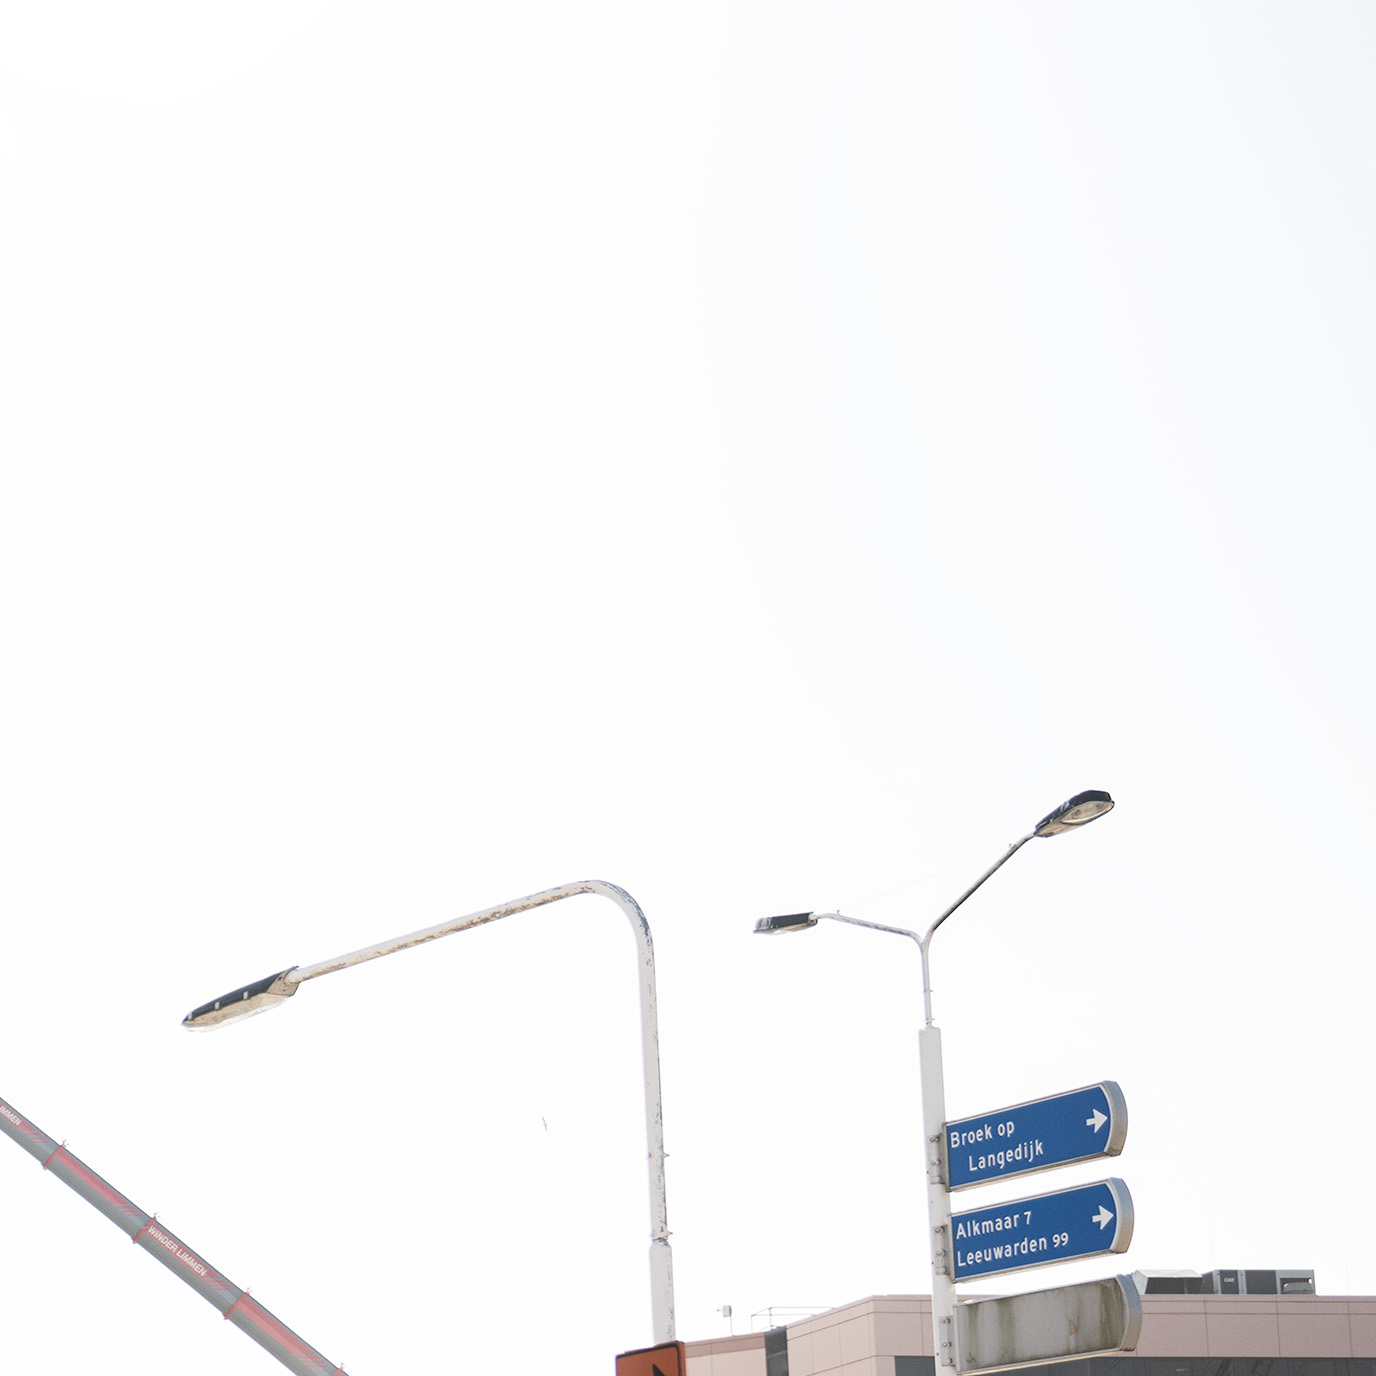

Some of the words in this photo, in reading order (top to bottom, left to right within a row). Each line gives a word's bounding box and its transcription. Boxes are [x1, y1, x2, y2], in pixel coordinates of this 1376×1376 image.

[950, 1124, 993, 1149] Broek
[997, 1120, 1015, 1137] op
[968, 1140, 1044, 1172] Langedijk
[956, 1214, 1019, 1240] Alkmaar
[1024, 1211, 1032, 1225] 7
[147, 1224, 179, 1254] WINDER
[176, 1247, 207, 1277] LIMMEN
[957, 1236, 1047, 1267] Leeuwarden
[1052, 1232, 1069, 1248] 99
